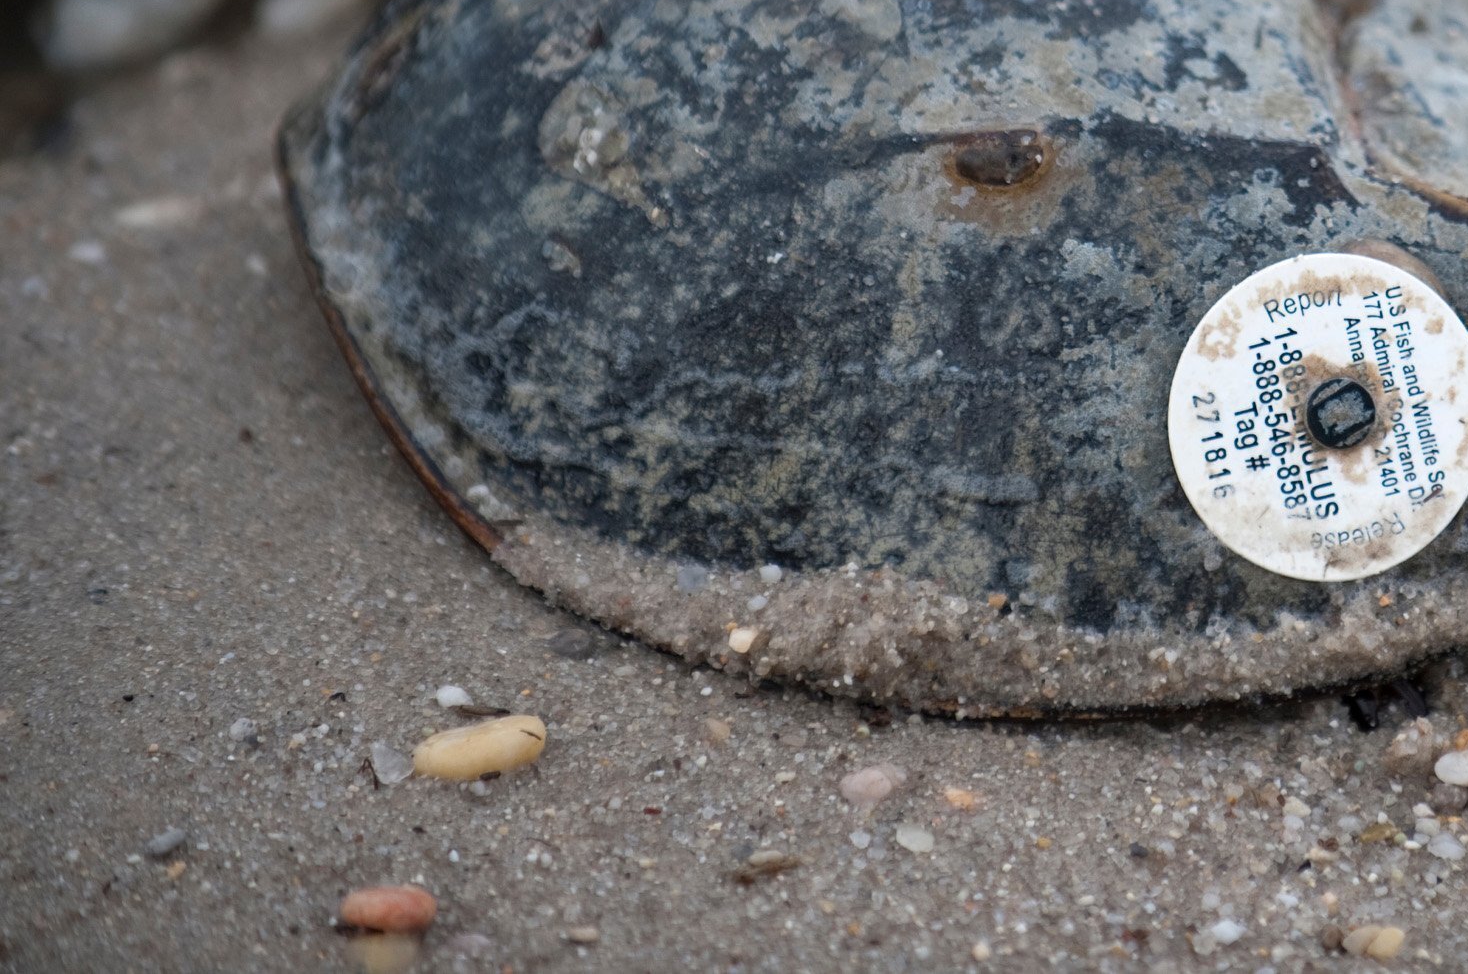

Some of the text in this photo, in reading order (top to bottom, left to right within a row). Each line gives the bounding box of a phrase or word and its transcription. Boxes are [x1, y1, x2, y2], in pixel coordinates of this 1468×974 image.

[1263, 287, 1342, 323] Report
[1363, 291, 1384, 319] 177
[1370, 327, 1400, 394] Admiral
[1393, 321, 1415, 360] Fish
[1403, 364, 1425, 397] and
[1234, 402, 1271, 471] Tag #
[1248, 337, 1311, 520] 1-888-546-8587
[1387, 399, 1417, 482] Cochrane
[1412, 399, 1440, 466] Wildlife
[1375, 446, 1400, 496] 21401
[1310, 512, 1405, 550] Release
